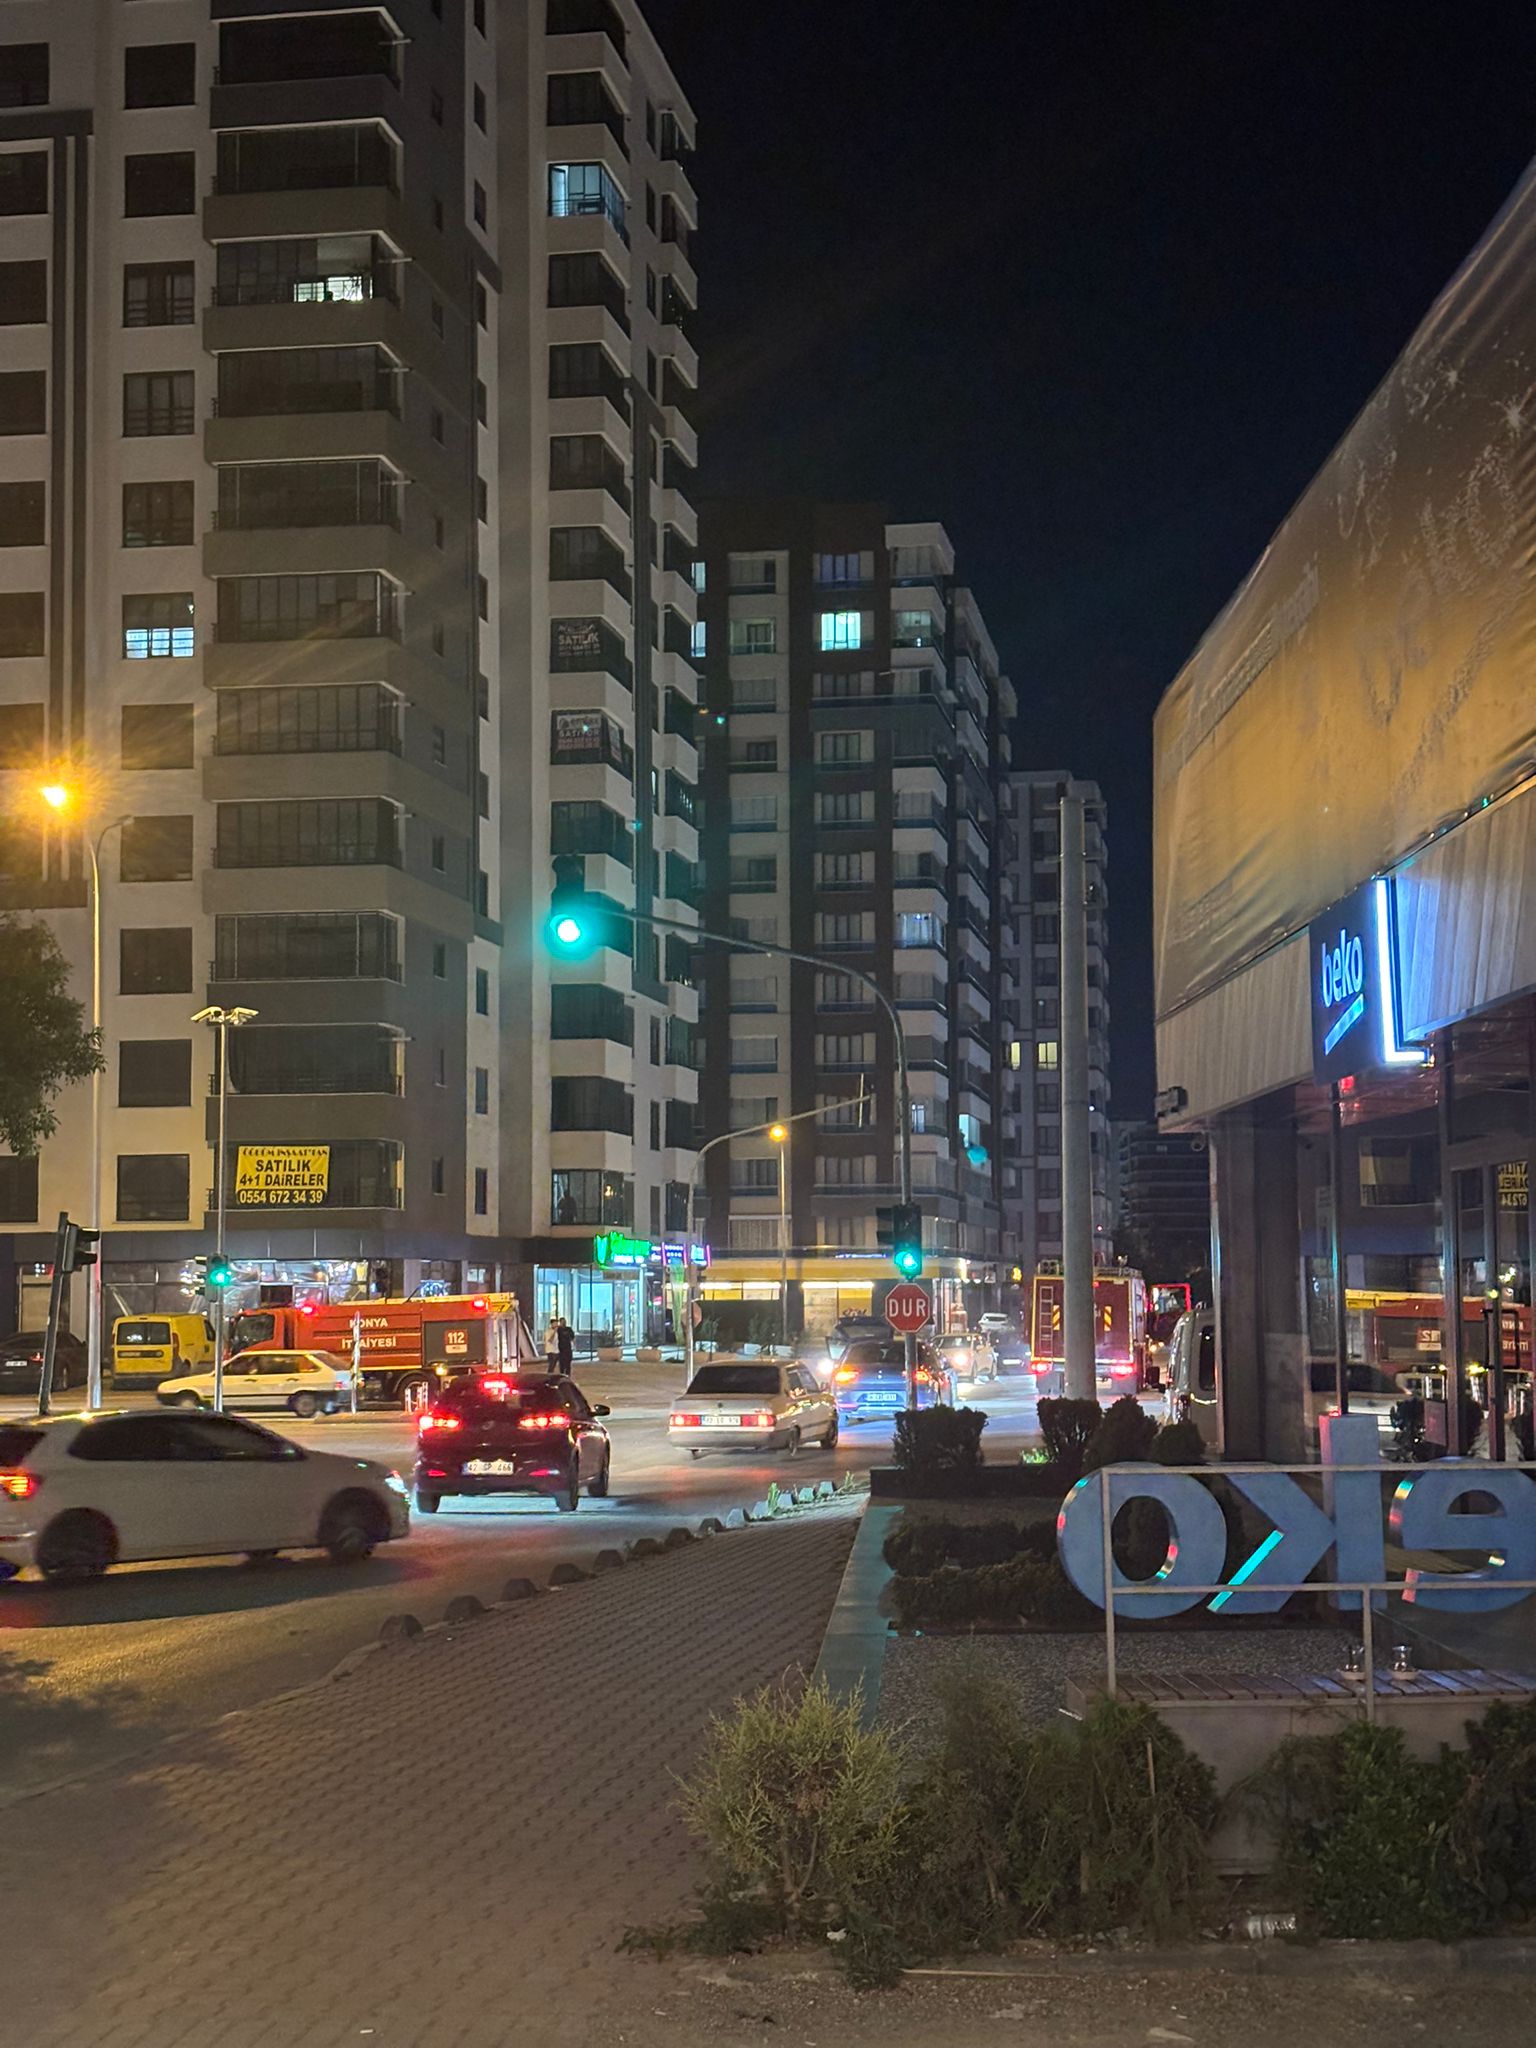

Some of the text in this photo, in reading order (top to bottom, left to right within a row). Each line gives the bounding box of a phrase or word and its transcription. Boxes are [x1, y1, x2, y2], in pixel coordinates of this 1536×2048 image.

[1322, 929, 1363, 1007] beko
[256, 1160, 311, 1172] SATILIK
[240, 1174, 260, 1185] 4+1
[240, 1190, 323, 1203] 0554 672 34 39
[889, 1298, 926, 1317] DUR
[342, 1336, 396, 1349] İTAİYESİ
[447, 1332, 465, 1344] 112
